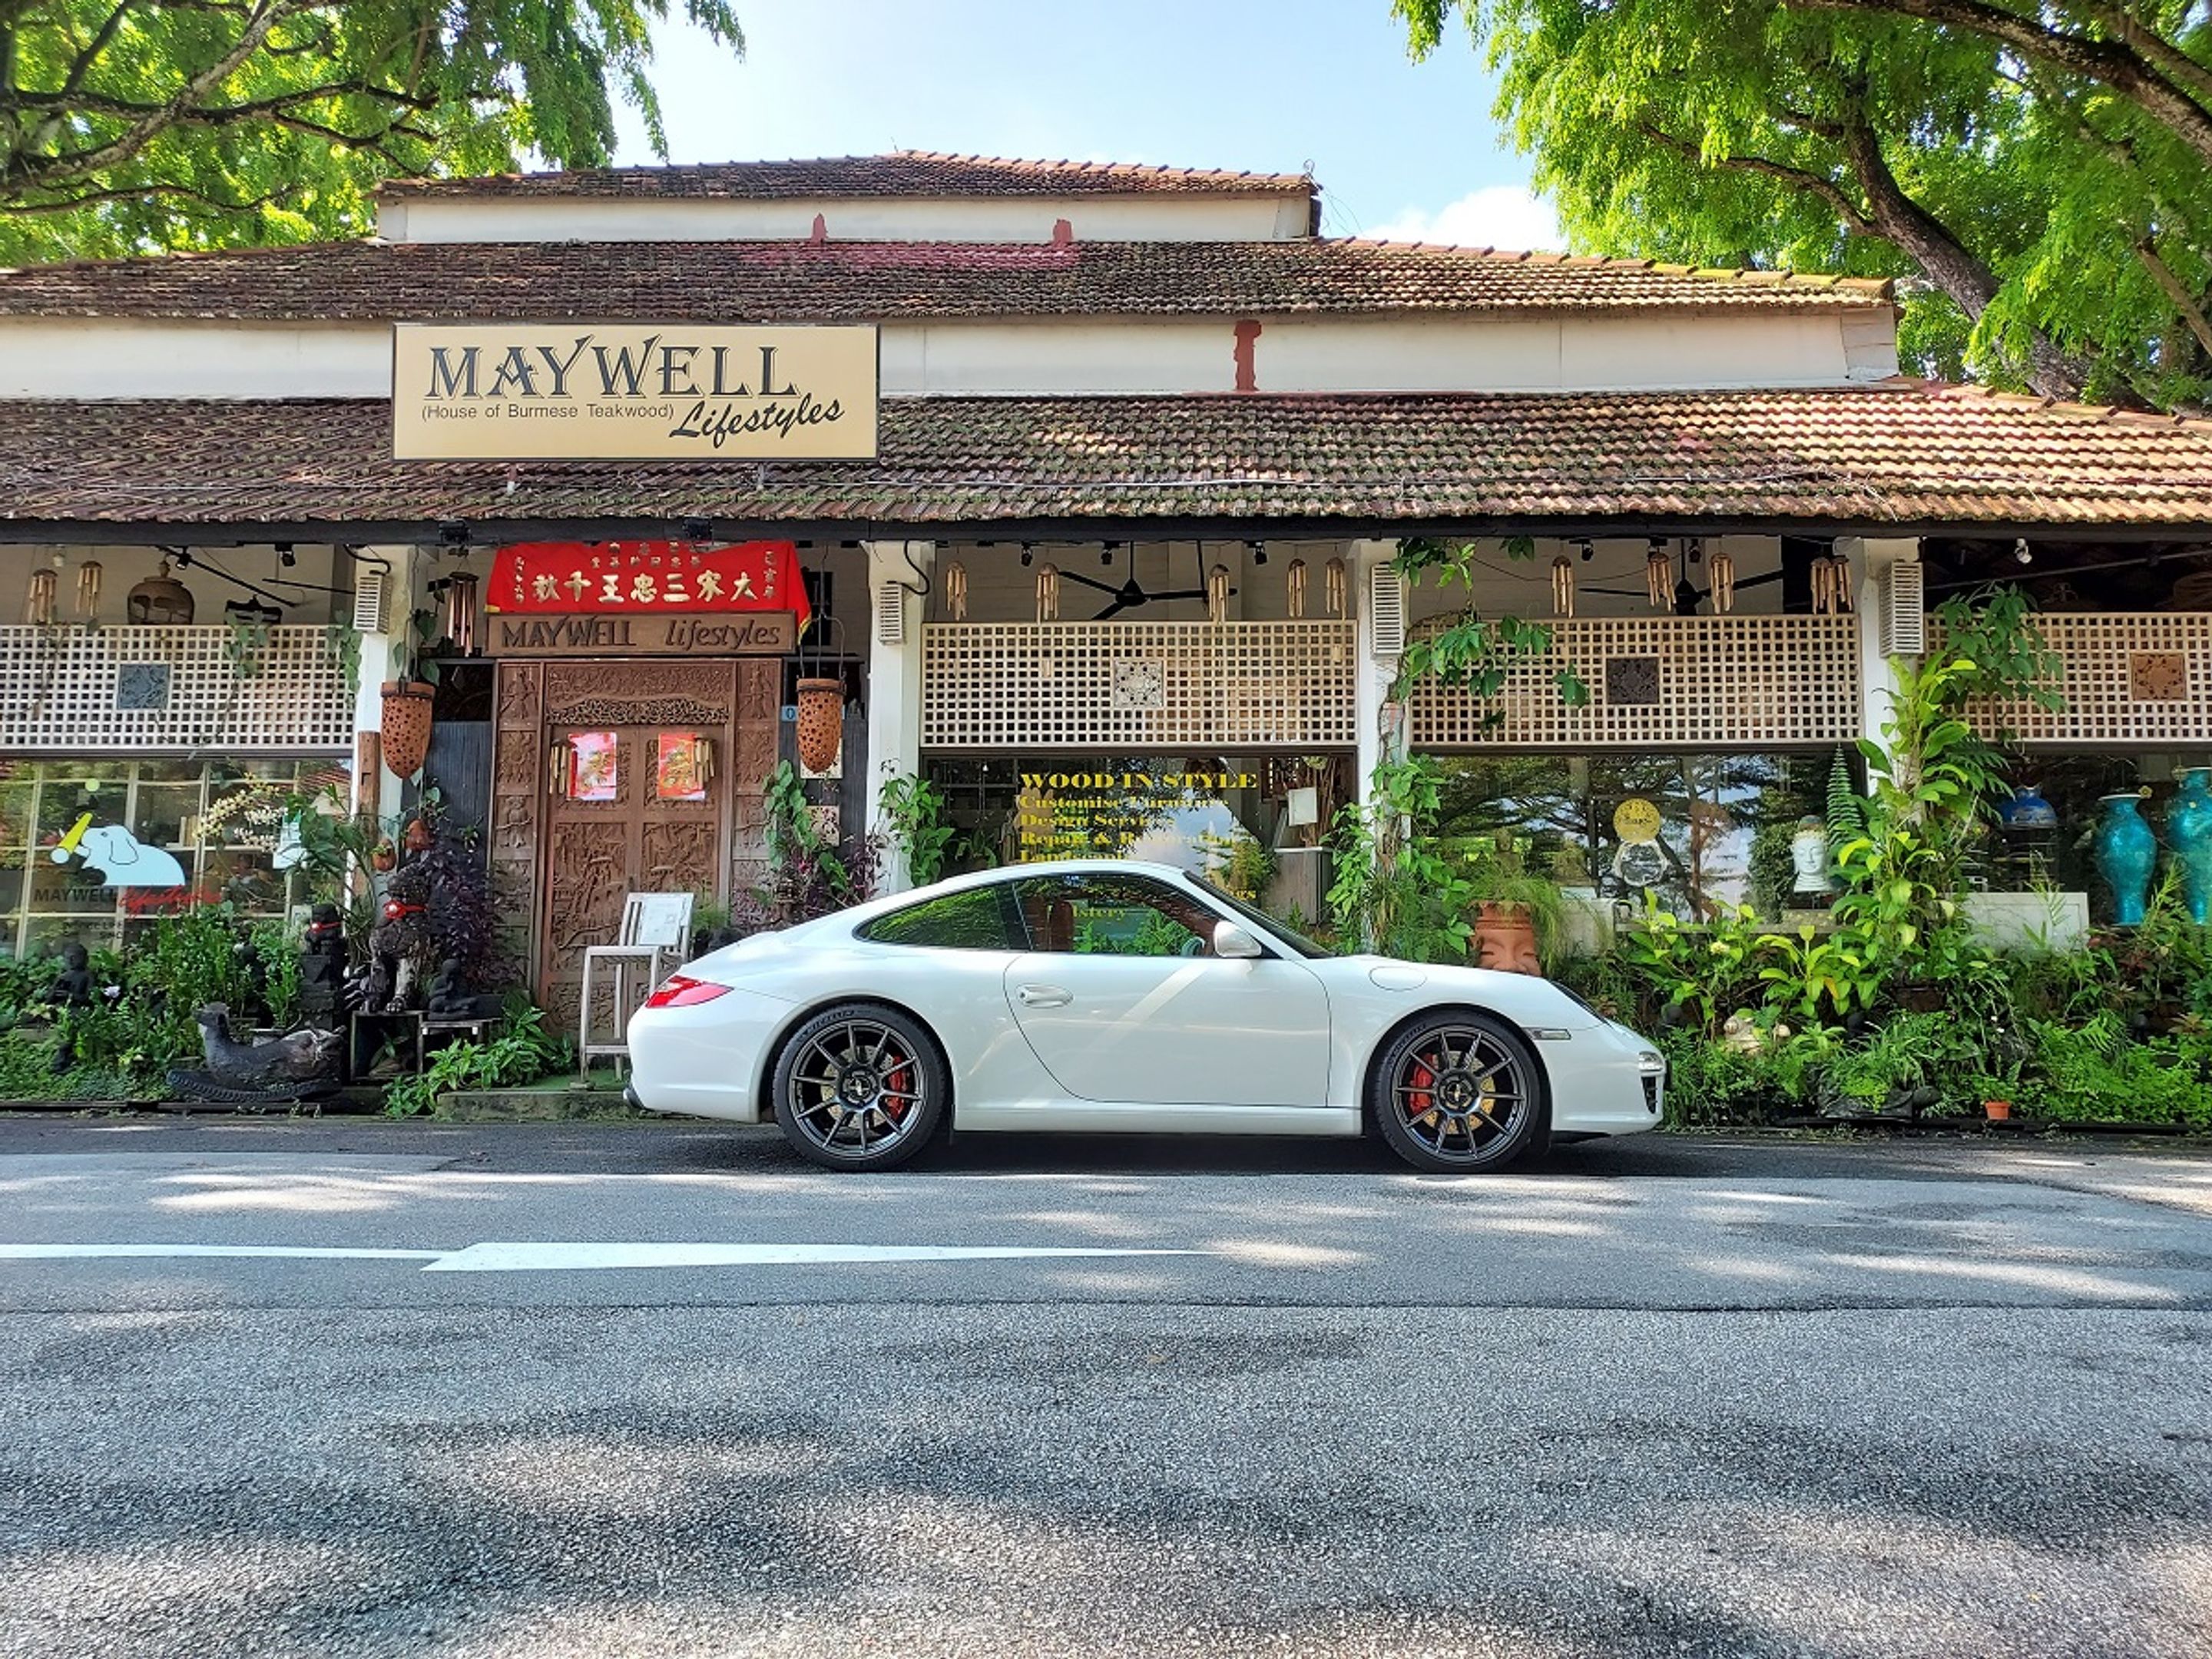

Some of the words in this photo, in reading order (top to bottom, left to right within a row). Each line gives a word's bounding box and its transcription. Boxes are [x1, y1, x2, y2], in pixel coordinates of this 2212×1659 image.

[422, 334, 802, 399] MAYWELL
[422, 404, 477, 421] (House
[485, 405, 501, 419] of
[508, 405, 578, 419] Burmese
[587, 404, 675, 421] Teakwood)
[669, 393, 844, 449] Lifestyles
[501, 617, 636, 647] MAYWELL
[665, 620, 780, 651] lifestyles
[1021, 773, 1114, 788] WOOD
[1124, 773, 1154, 788] IN
[1163, 773, 1258, 788] STYLE
[1019, 796, 1119, 808] Customise
[1020, 814, 1088, 827] Design
[1020, 831, 1086, 847] Repair
[1094, 831, 1111, 844] &
[33, 888, 118, 902] MAYWELL
